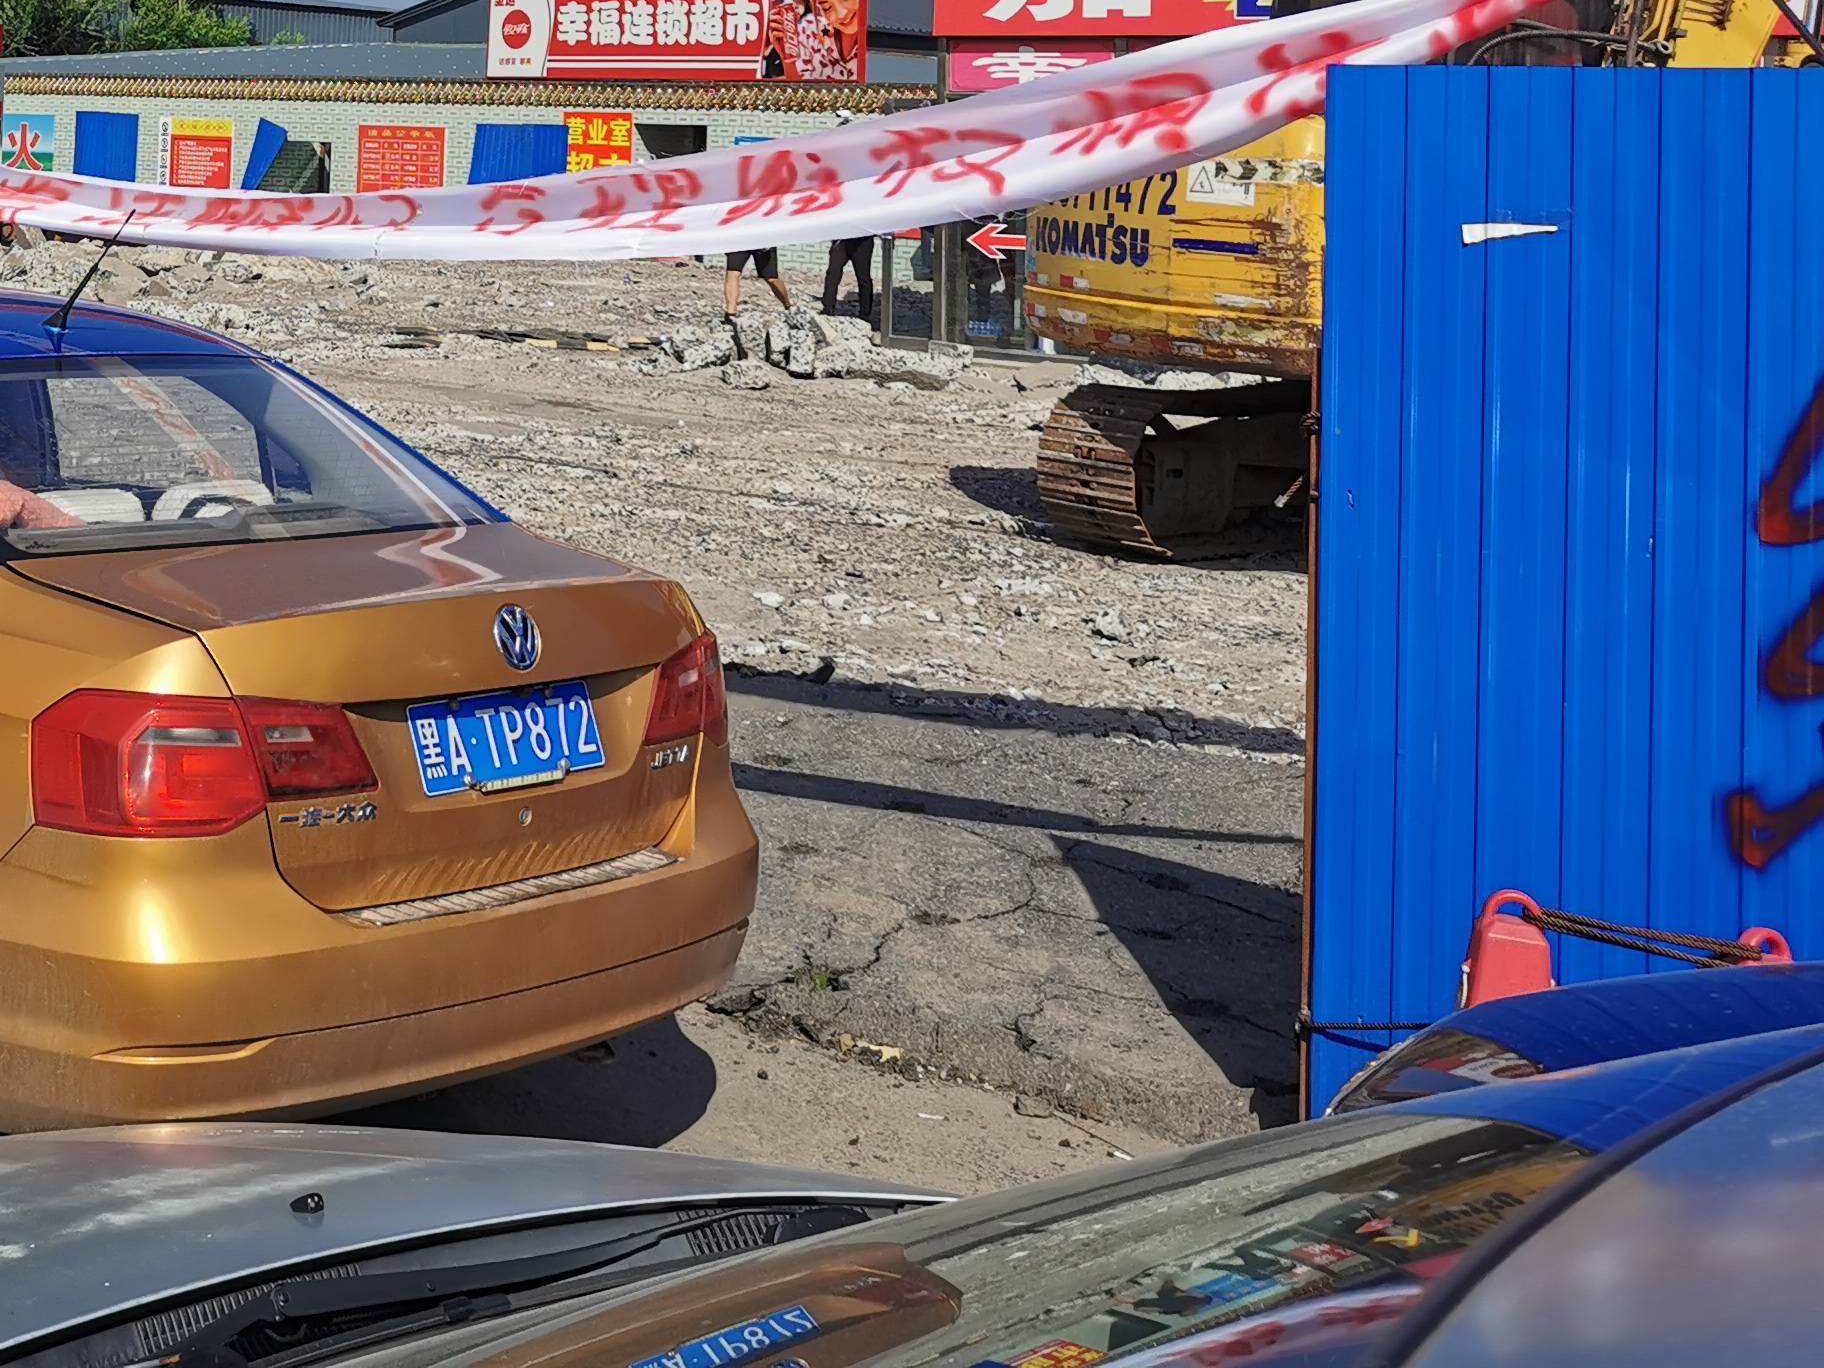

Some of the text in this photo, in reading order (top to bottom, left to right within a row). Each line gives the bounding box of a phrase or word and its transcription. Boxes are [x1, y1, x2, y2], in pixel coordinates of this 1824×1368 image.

[566, 117, 632, 147] 营业室
[1035, 213, 1151, 267] KOMATSU
